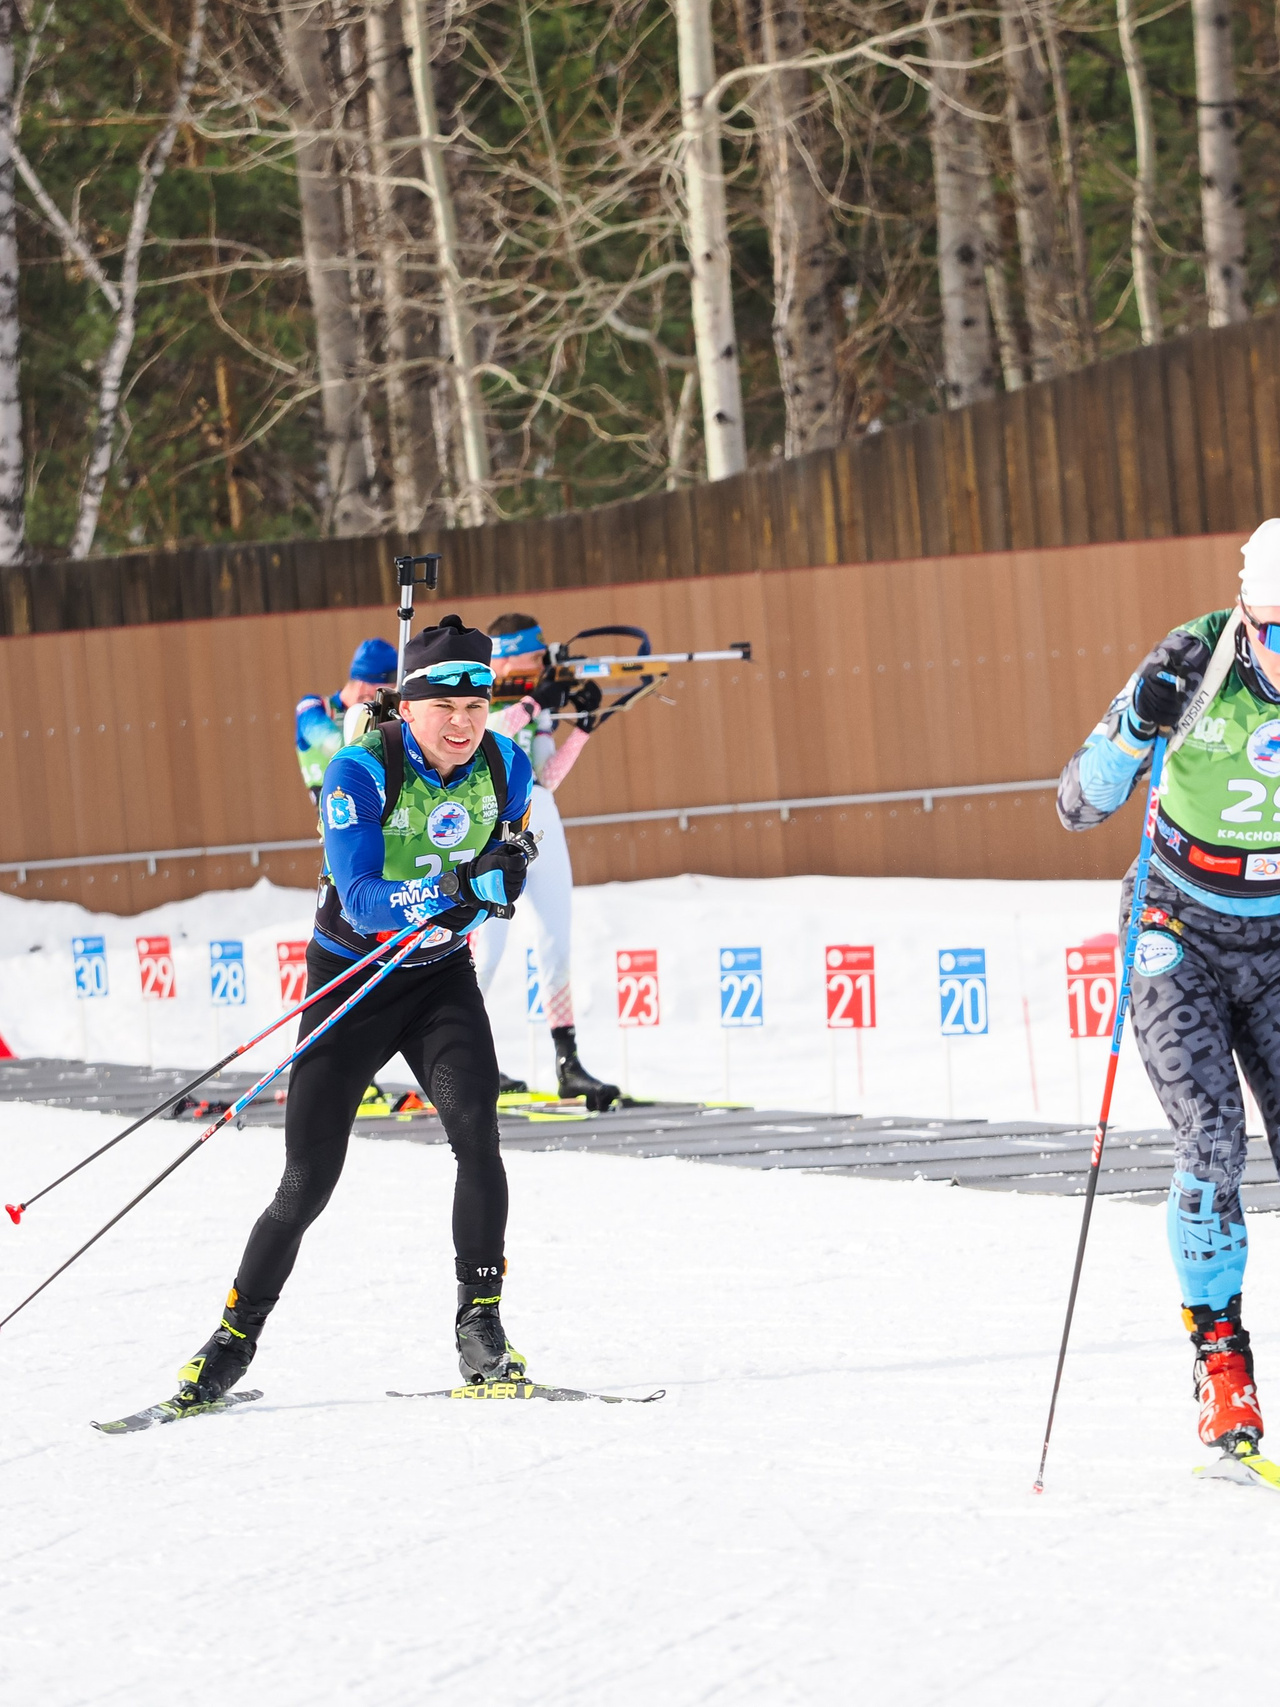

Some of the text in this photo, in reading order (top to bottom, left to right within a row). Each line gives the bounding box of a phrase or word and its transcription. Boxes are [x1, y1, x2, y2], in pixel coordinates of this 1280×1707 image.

[1181, 690, 1210, 730] LARSEN
[74, 954, 108, 998] 30
[141, 956, 176, 998] 29
[211, 961, 245, 1005] 28
[617, 975, 660, 1027] 23
[720, 974, 763, 1026] 22
[828, 975, 874, 1027] 21
[941, 978, 988, 1034] 20
[1069, 977, 1115, 1037] 19
[476, 1266, 498, 1277] 173
[451, 1383, 518, 1400] FISCHER
